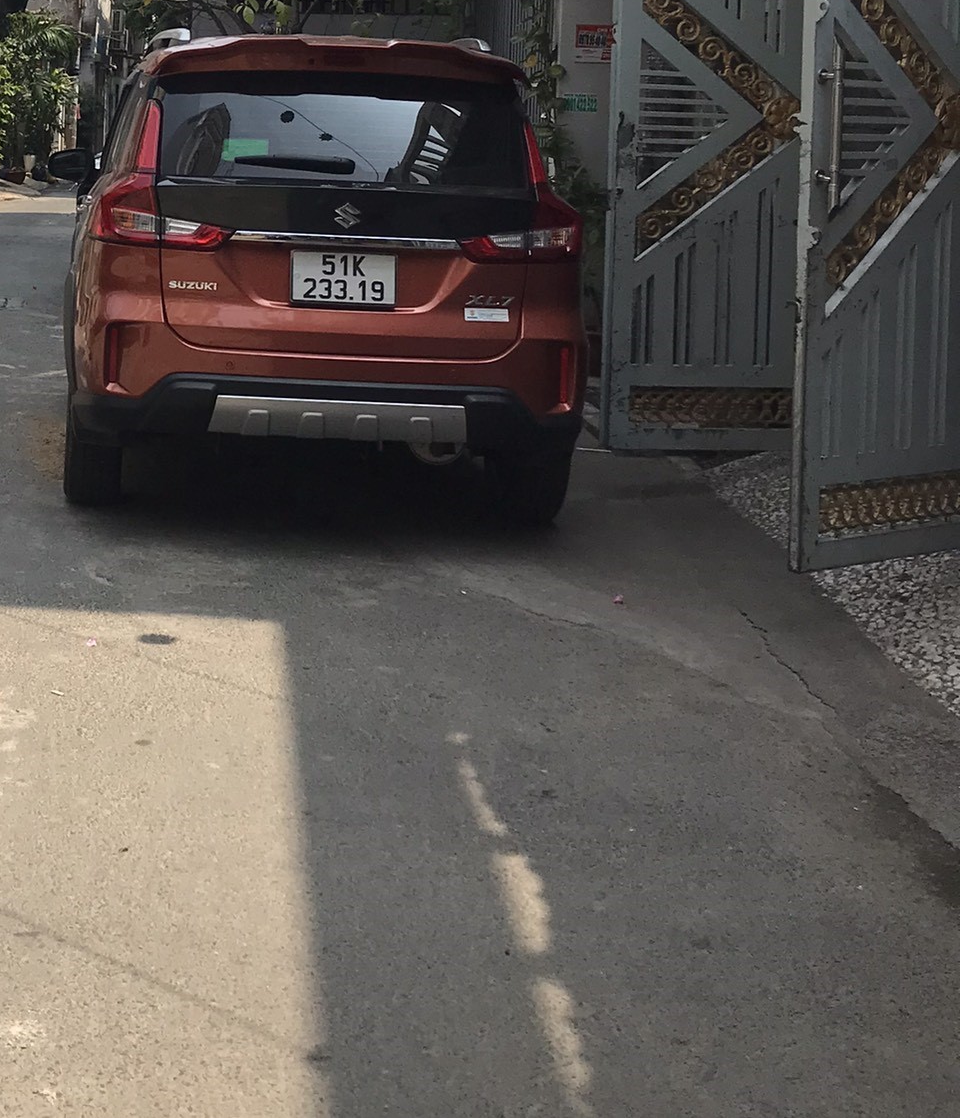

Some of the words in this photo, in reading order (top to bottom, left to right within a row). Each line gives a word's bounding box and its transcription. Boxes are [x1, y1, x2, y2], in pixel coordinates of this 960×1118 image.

[321, 254, 366, 277] 51K
[168, 280, 217, 292] SUZUKI
[302, 279, 385, 303] 233.19
